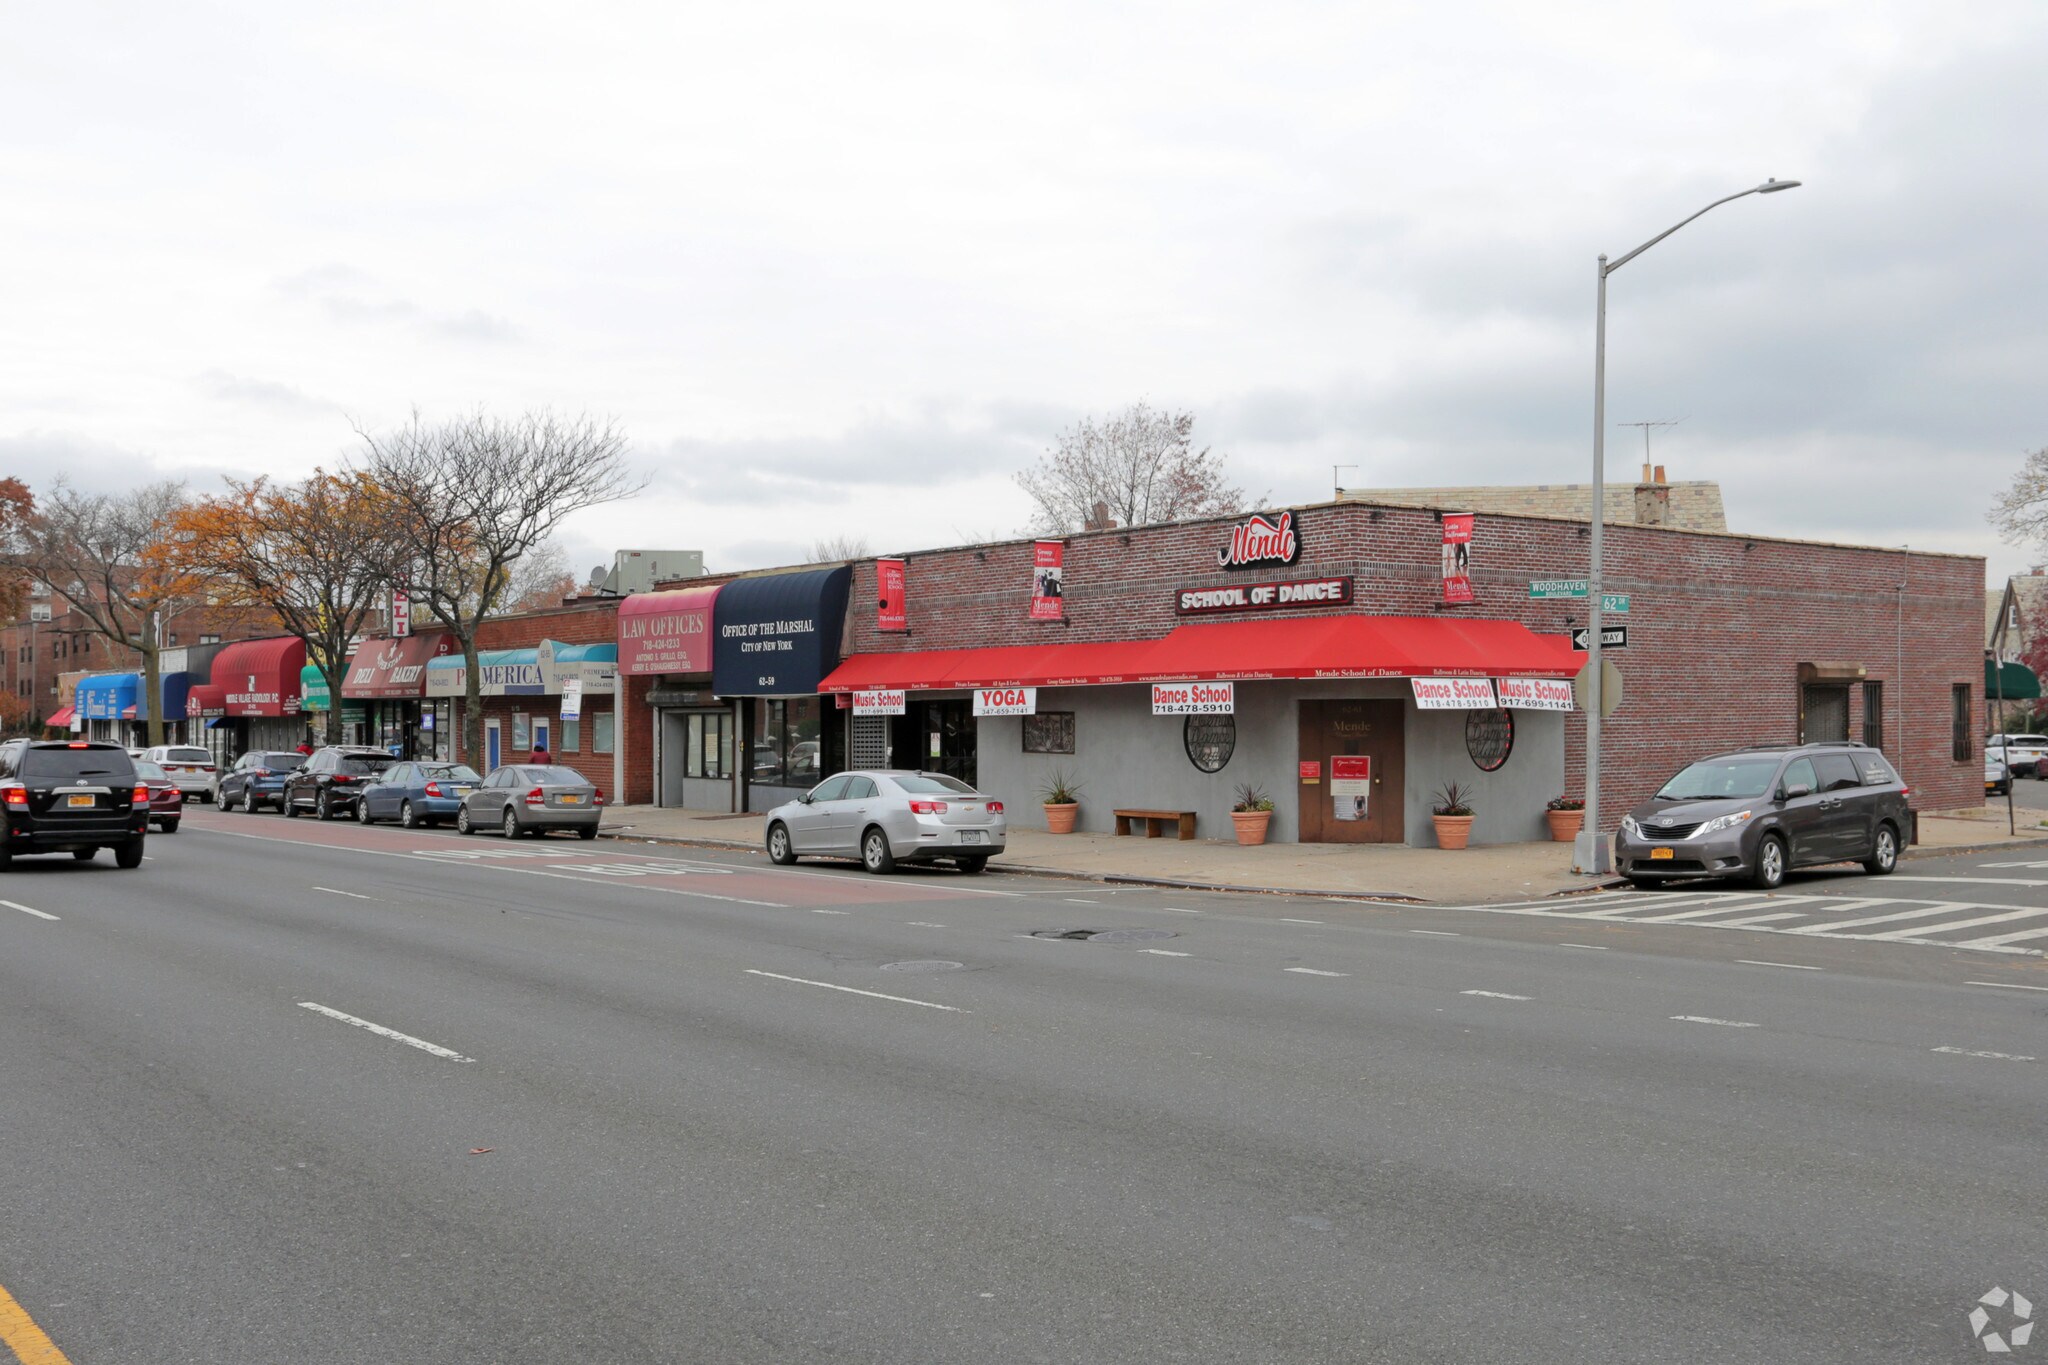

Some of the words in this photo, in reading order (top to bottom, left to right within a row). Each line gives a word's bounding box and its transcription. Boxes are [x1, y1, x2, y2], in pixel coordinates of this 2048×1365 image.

[1218, 512, 1296, 566] Mende
[1532, 582, 1587, 592] WOODHAVEN
[1181, 588, 1247, 609] SCHOOL
[1251, 587, 1276, 604] OF
[1279, 581, 1341, 603] DANCE
[1034, 599, 1059, 609] Mende
[1604, 597, 1616, 610] 62
[622, 618, 647, 639] LAW
[650, 613, 704, 637] OFFICES
[642, 638, 681, 650] 718-424-1233
[1602, 633, 1620, 643] WAY
[352, 668, 376, 684] DELI
[389, 665, 423, 683] BAKERY
[456, 665, 545, 687] PMERICA
[1315, 669, 1340, 677] Mende
[1341, 669, 1366, 677] School
[758, 677, 775, 686] 62-59
[1153, 686, 1188, 704] Dance
[1191, 684, 1231, 703] School
[1413, 680, 1451, 698] Dance
[1452, 679, 1493, 699] School
[1499, 678, 1532, 698] Music
[1534, 680, 1571, 701] School
[854, 693, 876, 707] Music
[877, 691, 904, 706] School
[981, 690, 1026, 707] YOGA
[1424, 700, 1489, 708] 718-478-5910
[1500, 698, 1572, 709] 917-699-1141
[1154, 704, 1231, 713] 718-478-5910
[1334, 720, 1372, 732] Mende
